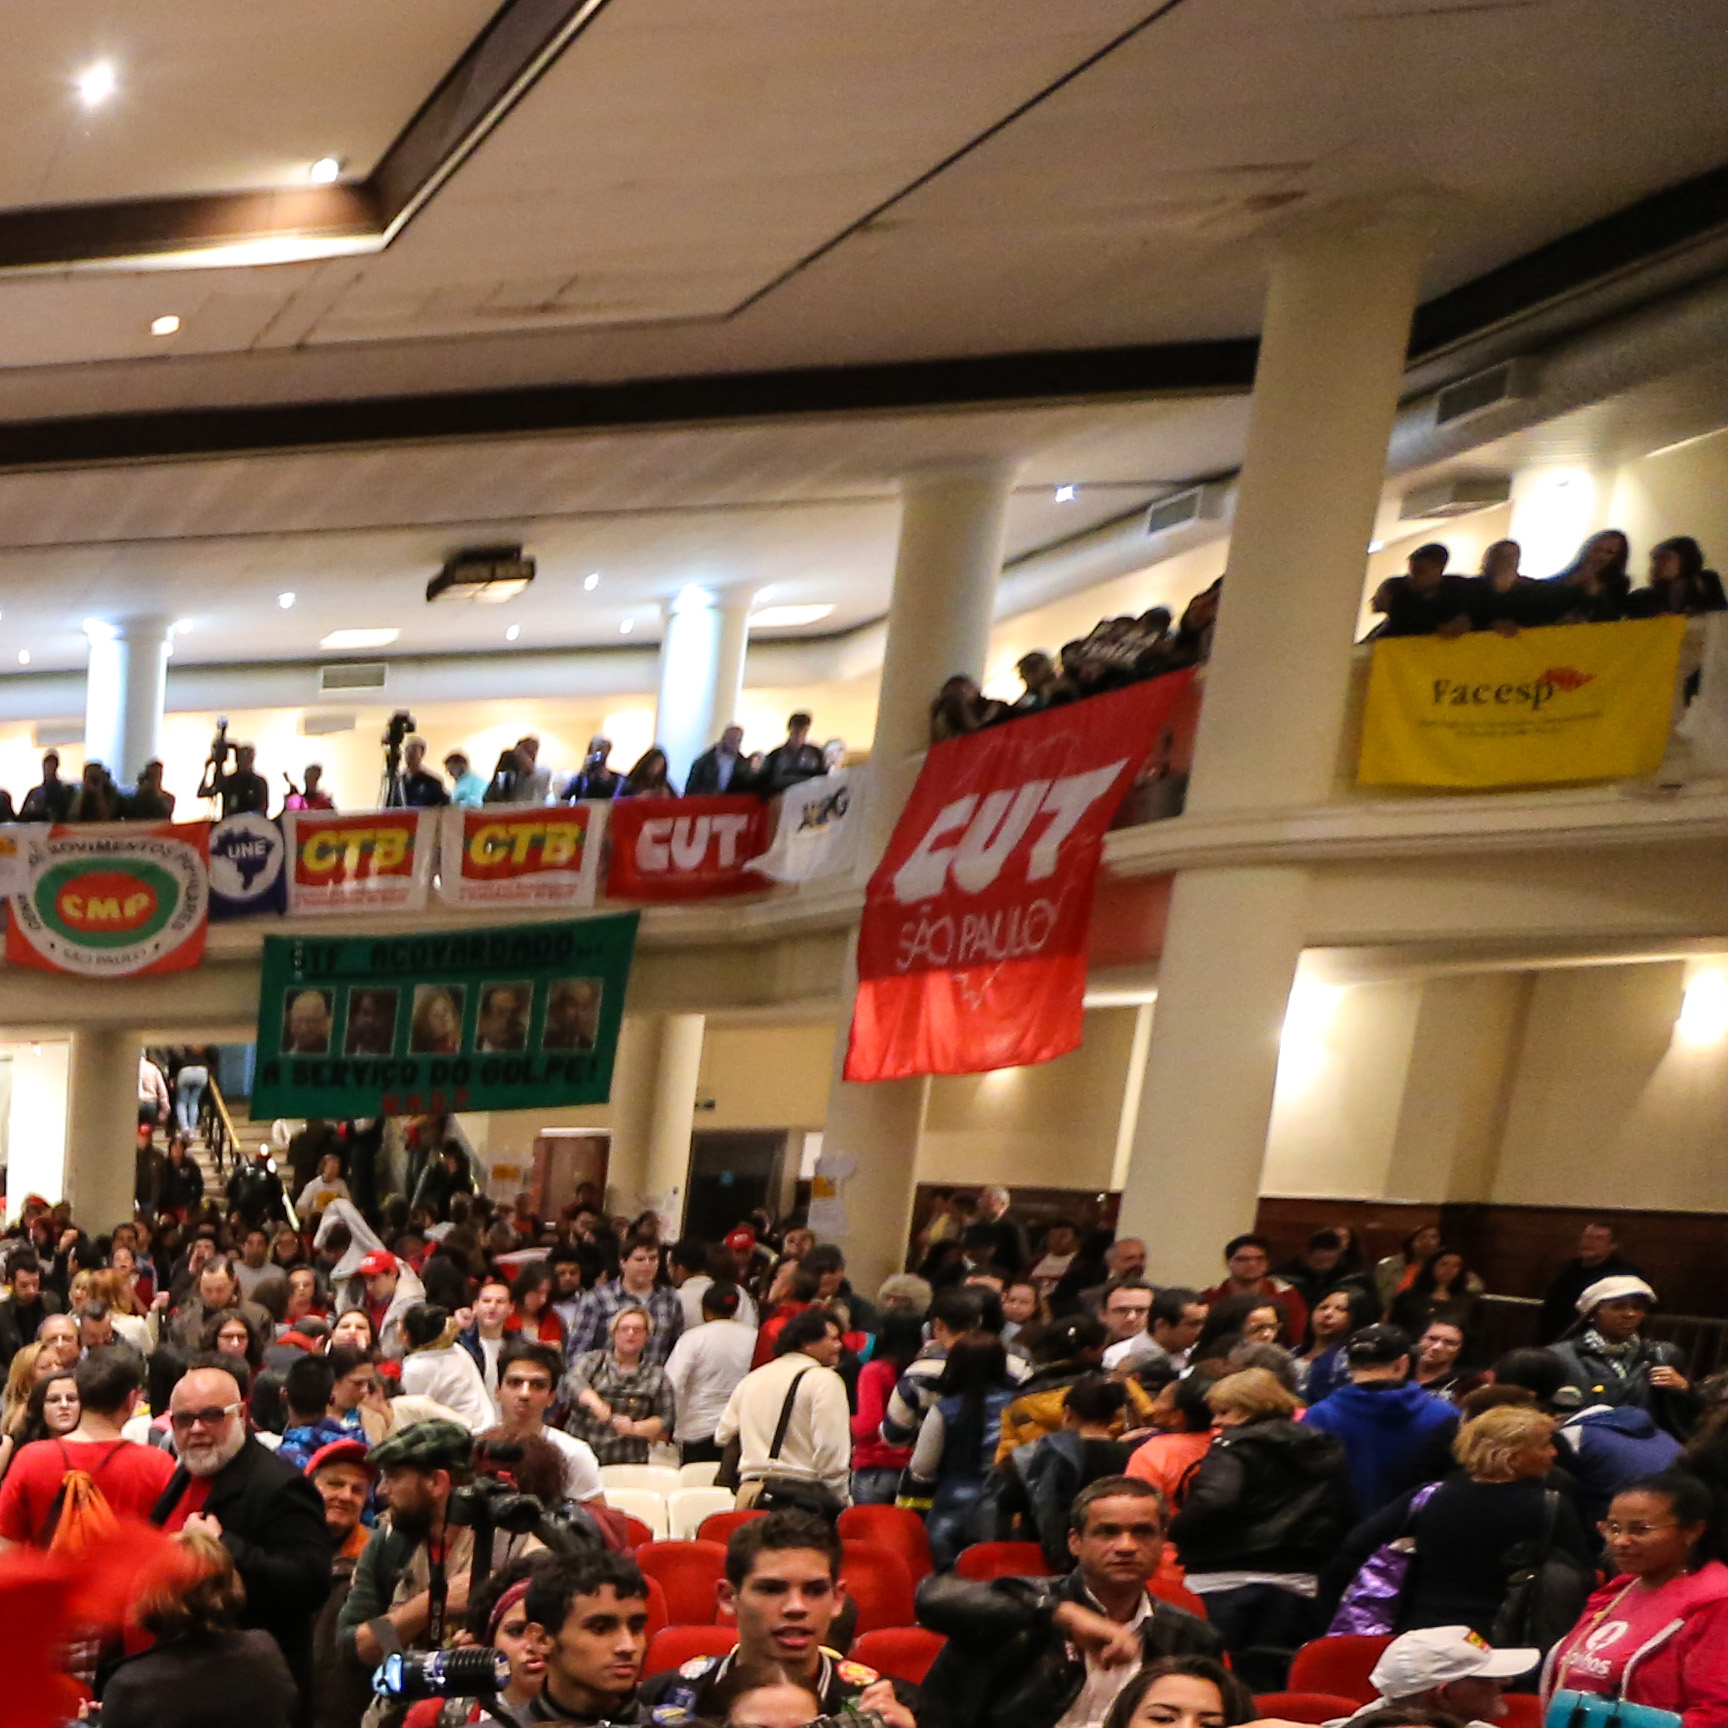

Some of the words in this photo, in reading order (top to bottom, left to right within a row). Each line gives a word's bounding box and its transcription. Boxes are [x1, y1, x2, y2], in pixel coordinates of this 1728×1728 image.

[1432, 678, 1554, 711] Facesp
[228, 839, 267, 859] UNE
[303, 828, 410, 871] CTB
[469, 822, 580, 866] CTB
[635, 814, 748, 872] CUT
[893, 757, 1131, 903] CUT
[61, 893, 150, 919] CMP
[897, 904, 955, 970] SÃO
[958, 898, 1057, 962] PAULO
[428, 1057, 472, 1085] DO
